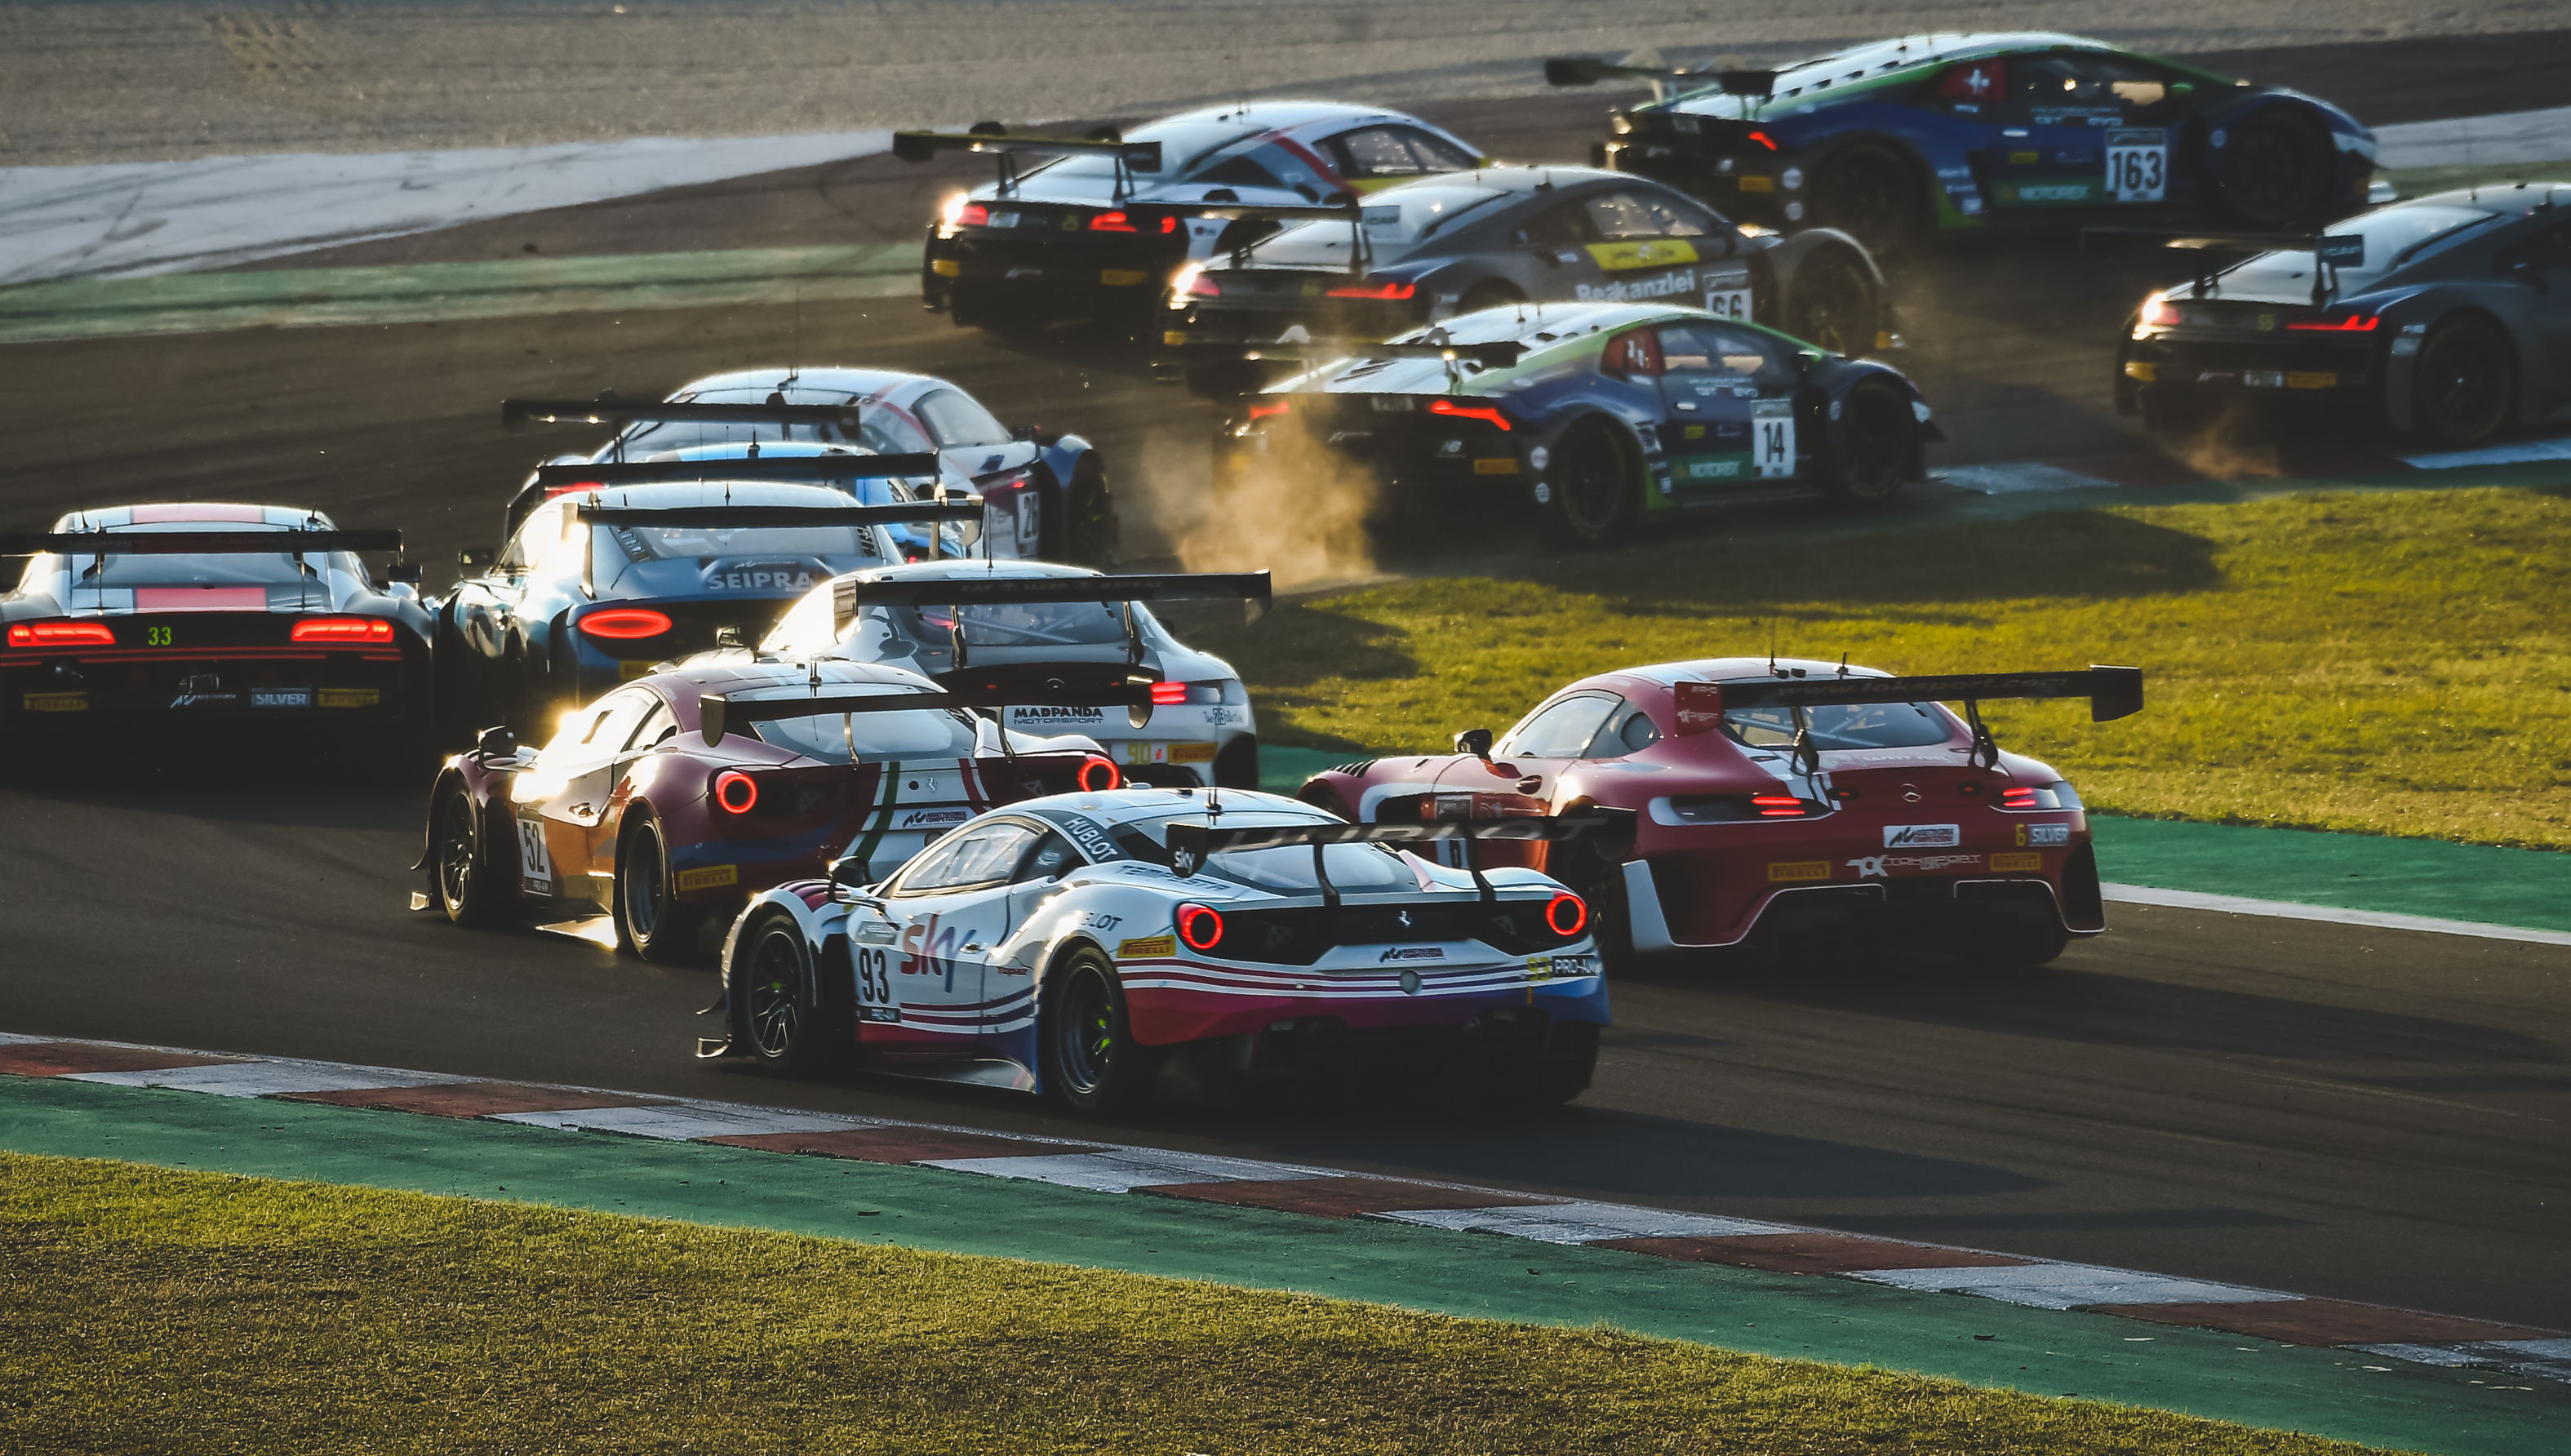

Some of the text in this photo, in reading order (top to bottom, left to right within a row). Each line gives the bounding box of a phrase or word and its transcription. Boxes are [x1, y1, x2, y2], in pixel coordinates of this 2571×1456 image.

[2111, 151, 2163, 190] 163
[1764, 421, 1785, 464] 14
[148, 626, 172, 646] 33
[255, 694, 308, 705] SILVER
[1014, 707, 1103, 718] MADPANDA
[1127, 744, 1152, 766] 90
[1063, 816, 1119, 861] HUBLOT
[2015, 823, 2027, 846] 6
[2031, 827, 2068, 842] SILVER
[522, 821, 545, 873] 52
[1174, 846, 1196, 875] sky
[683, 868, 731, 888] PIRELLI
[899, 909, 978, 994] sky
[1123, 939, 1170, 955] PIRELLI
[859, 947, 890, 1005] 93
[1526, 957, 1550, 982] 93
